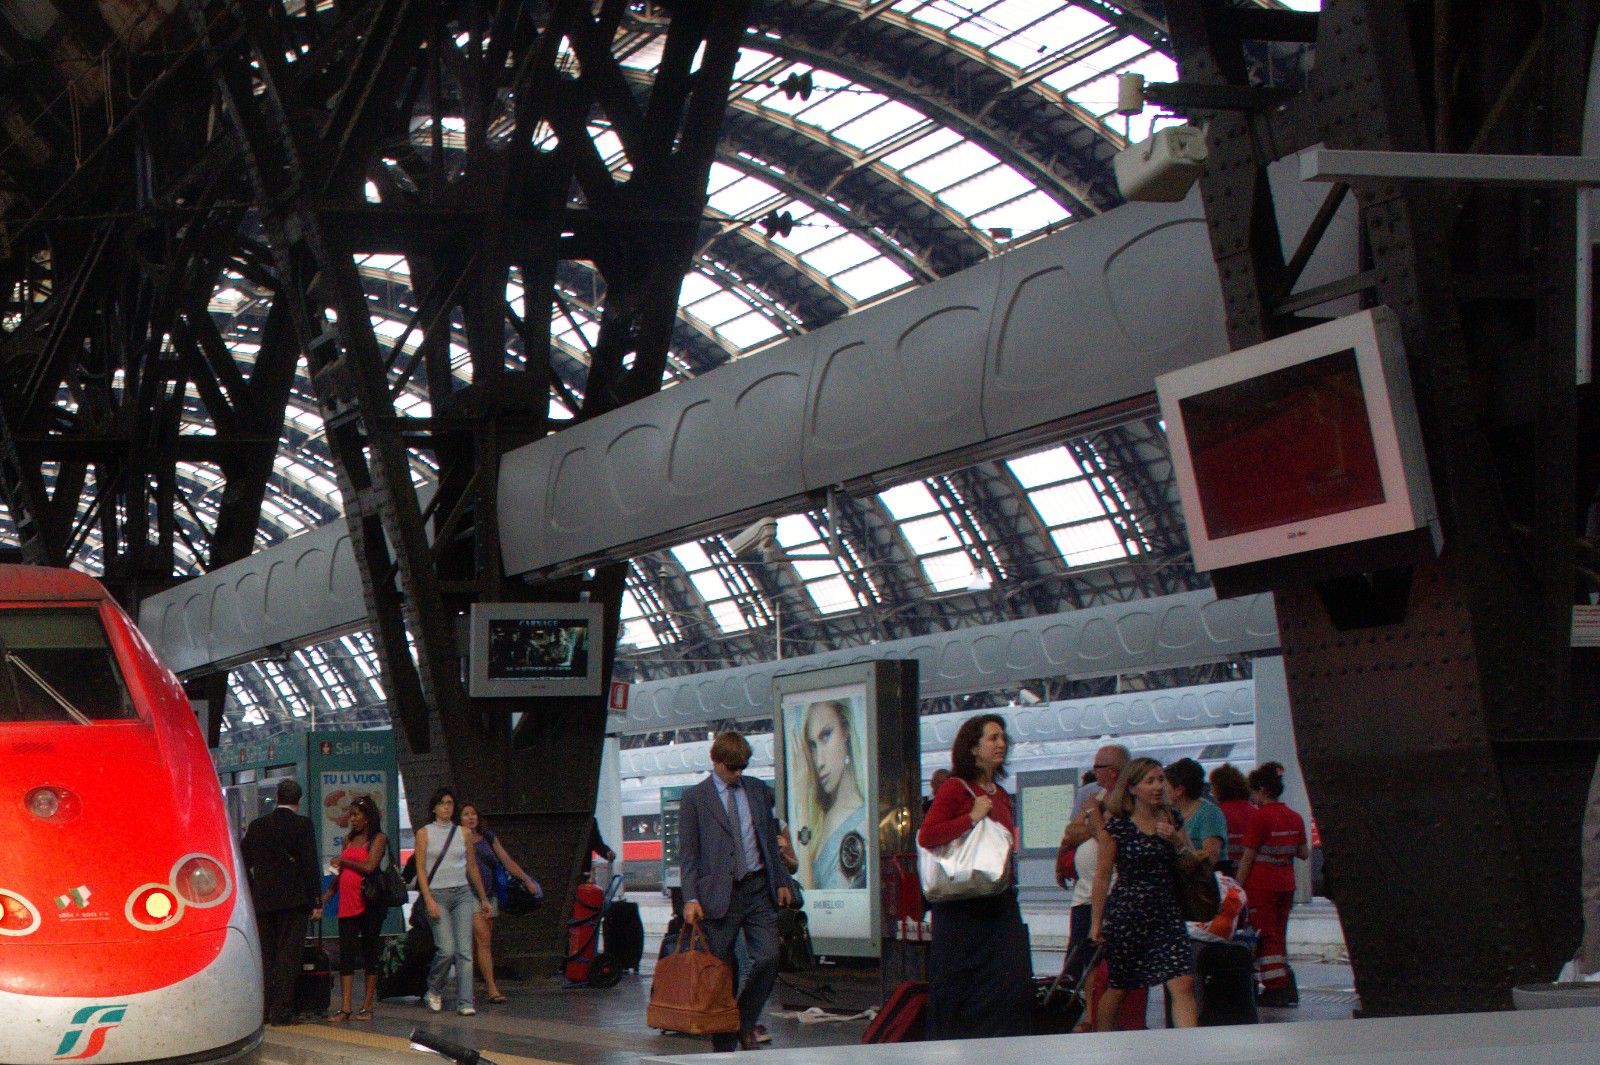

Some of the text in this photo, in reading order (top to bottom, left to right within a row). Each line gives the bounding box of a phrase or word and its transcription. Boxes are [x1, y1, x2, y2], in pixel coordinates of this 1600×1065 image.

[335, 742, 385, 755] Self Bar
[323, 774, 338, 784] TU
[341, 774, 350, 784] LI
